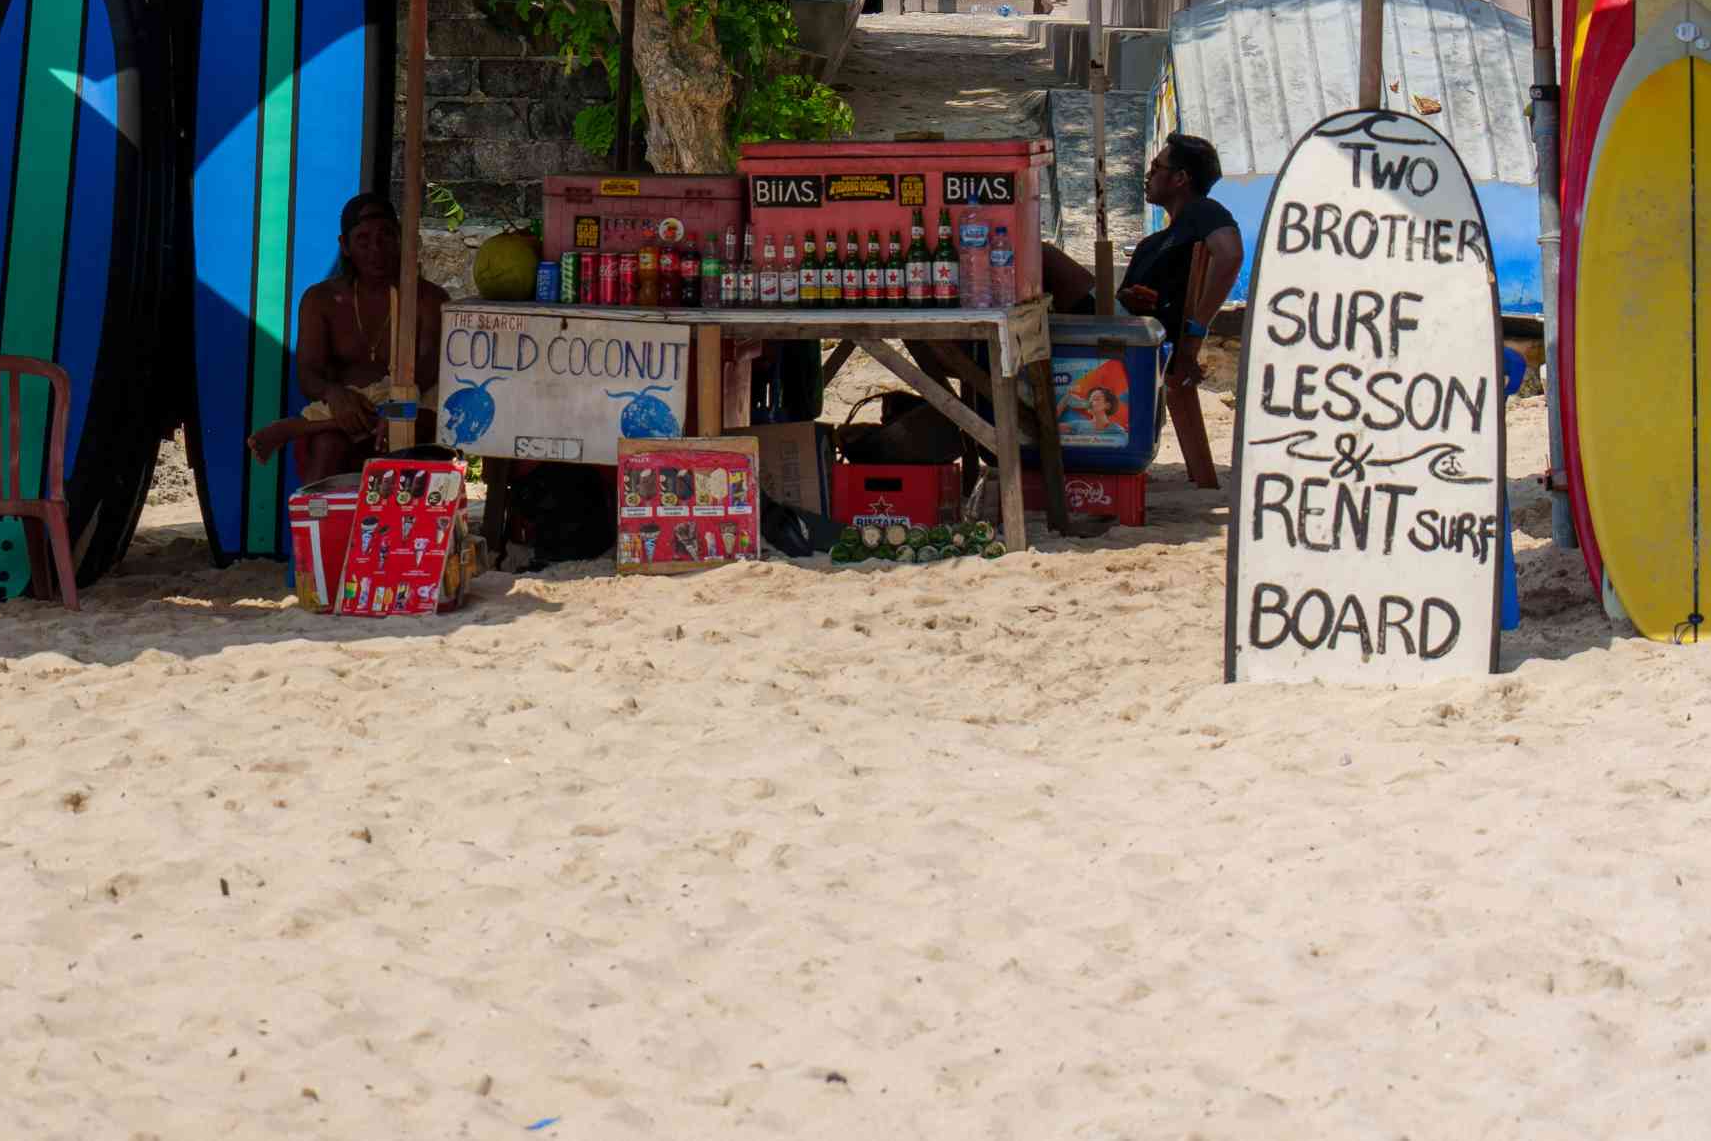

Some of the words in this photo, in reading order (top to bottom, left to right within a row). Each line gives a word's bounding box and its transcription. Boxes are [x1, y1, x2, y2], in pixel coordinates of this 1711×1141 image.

[1339, 142, 1438, 197] TWO
[1277, 202, 1486, 264] BROTHER
[446, 329, 539, 371] COLD
[547, 336, 688, 380] COCONUT
[1267, 287, 1424, 360] SURF
[1261, 363, 1487, 434] LESSON
[1329, 432, 1374, 483] &
[1253, 473, 1418, 556] RENT
[1407, 509, 1497, 565] SURF
[1250, 582, 1461, 660] BOARD
